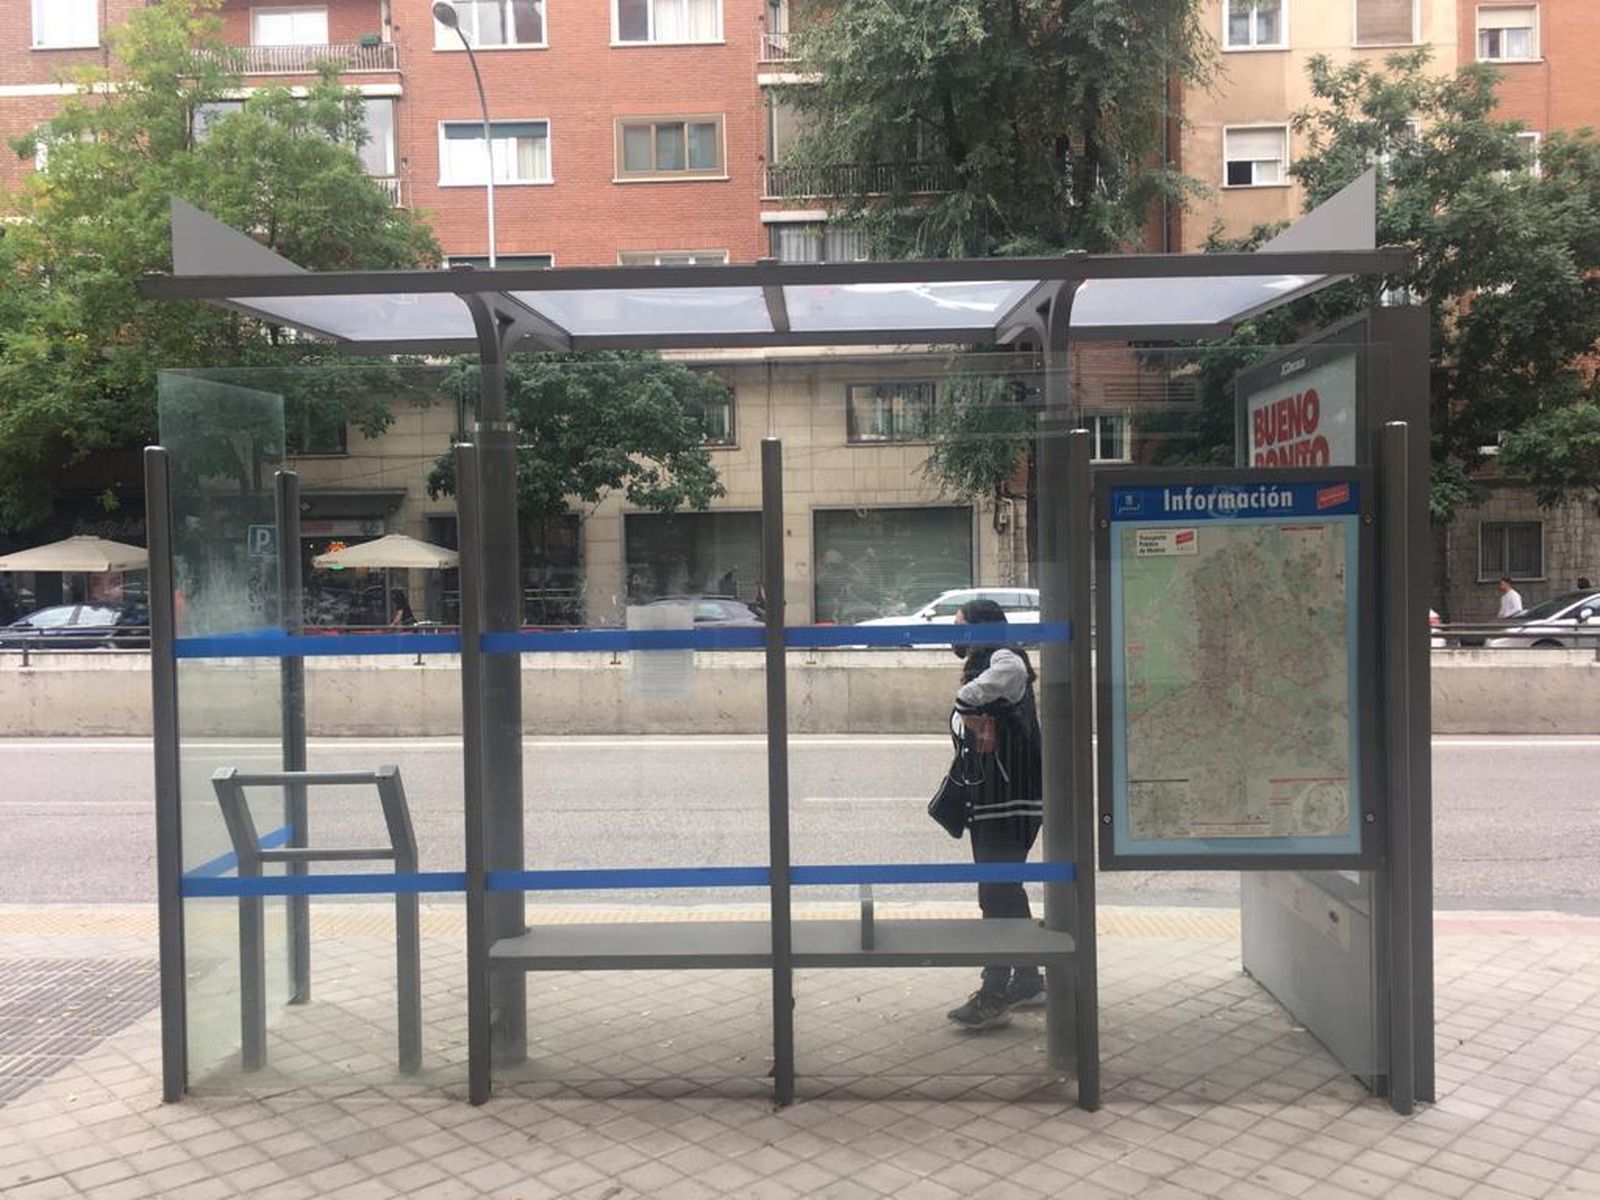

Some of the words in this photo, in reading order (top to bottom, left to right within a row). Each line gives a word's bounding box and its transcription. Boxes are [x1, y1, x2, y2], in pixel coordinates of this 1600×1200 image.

[1253, 388, 1320, 451] BUENO
[1163, 485, 1293, 512] Información
[256, 528, 271, 549] P
